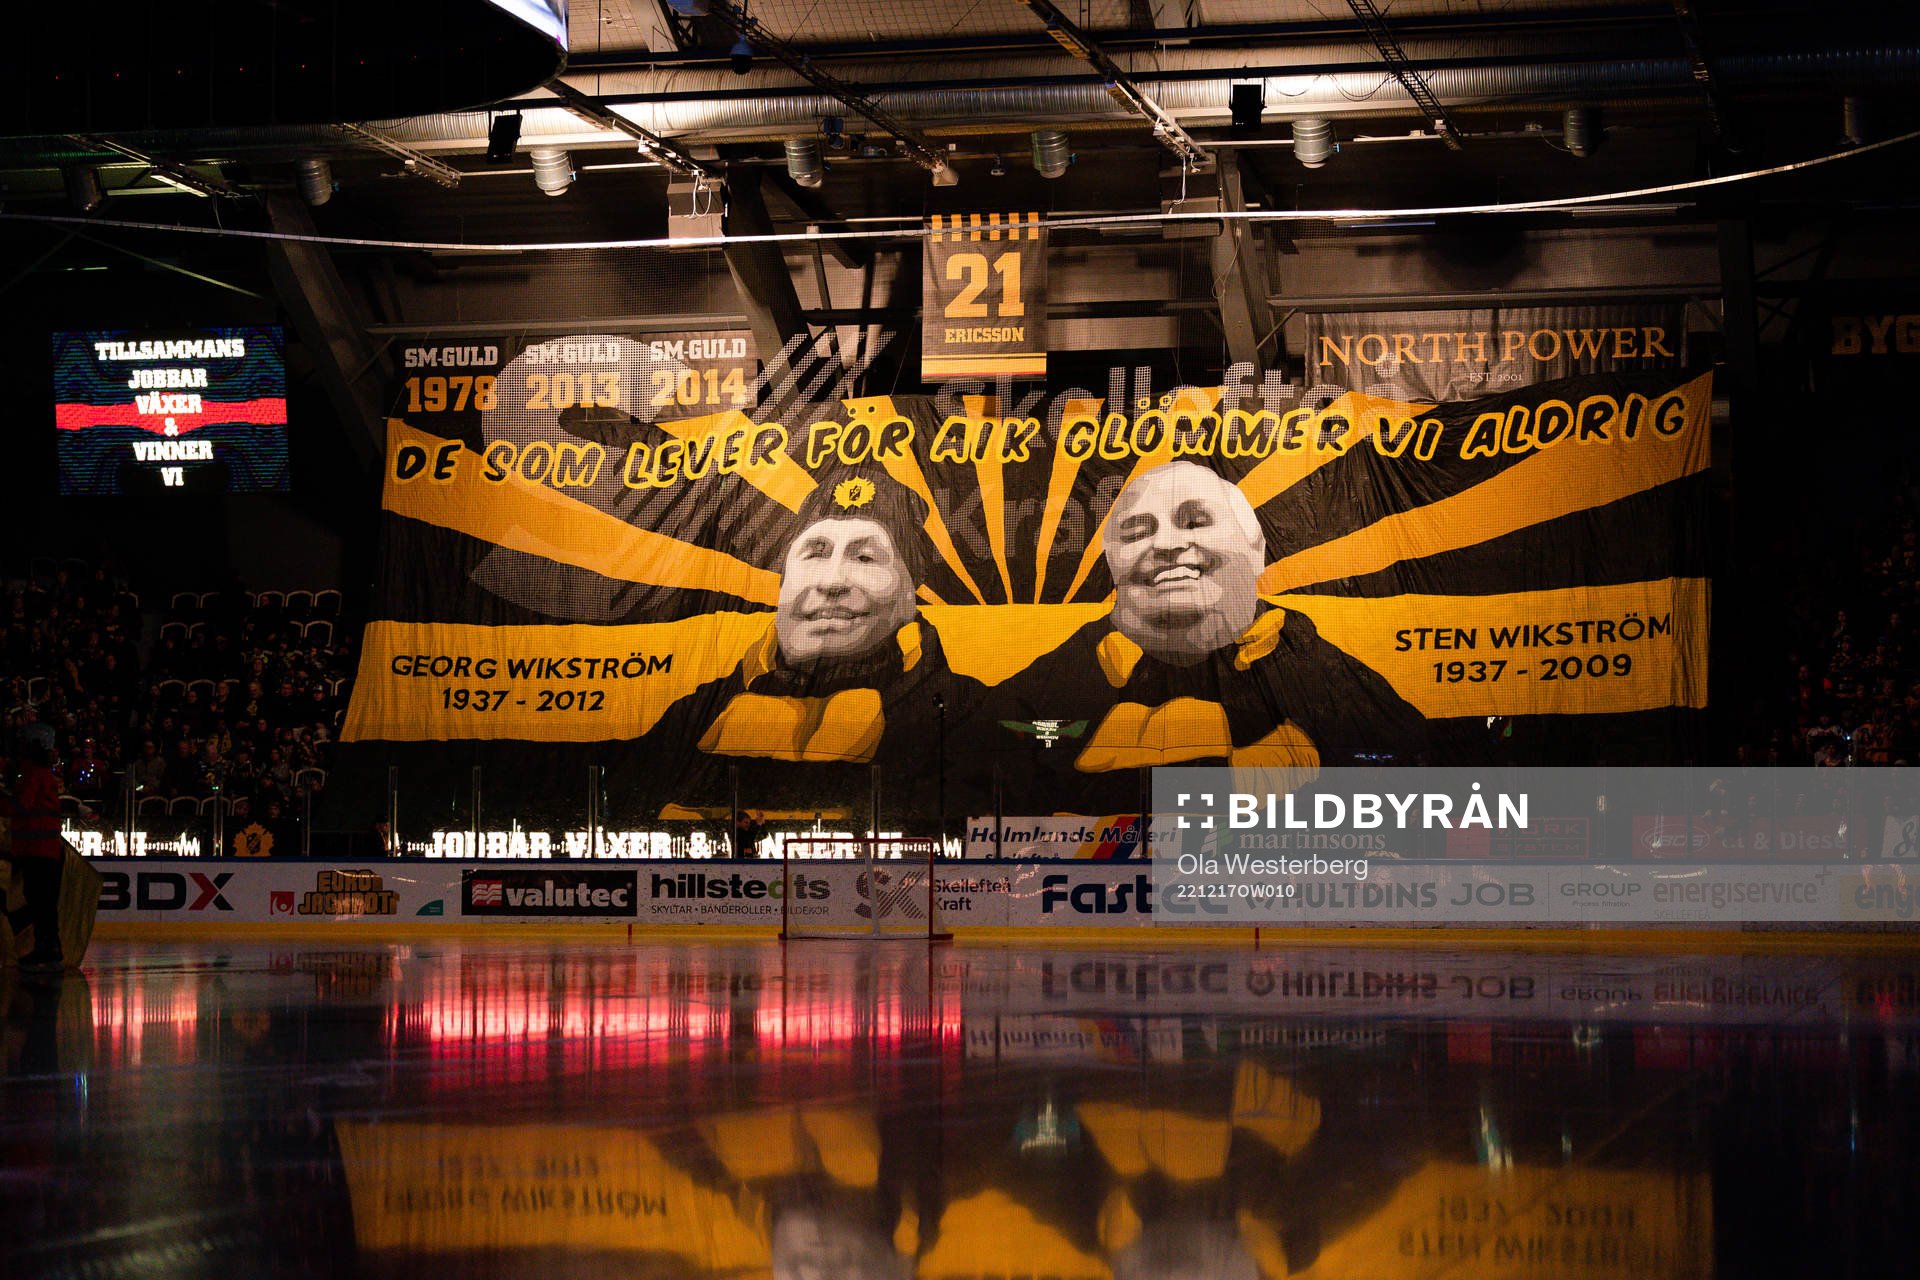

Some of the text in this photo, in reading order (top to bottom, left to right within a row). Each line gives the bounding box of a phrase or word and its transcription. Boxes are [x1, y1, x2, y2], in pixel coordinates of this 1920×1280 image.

[944, 251, 1025, 318] 21
[944, 327, 1025, 344] ERICSSON
[1318, 326, 1675, 367] NORTH POWER
[95, 339, 245, 361] TILLSAMMANS
[404, 346, 499, 369] SM-GULD
[525, 341, 622, 364] SM-GULD
[650, 337, 747, 360] SM-GULD
[128, 368, 208, 389] JOBBAR
[650, 366, 749, 407] 2014
[134, 391, 203, 415] VÄXER
[404, 375, 498, 413] 1978
[525, 371, 622, 411] 2013
[164, 417, 179, 437] &
[132, 440, 214, 461] VINNER
[390, 390, 1693, 490] DE SOM LEVER FÖR AIK GLÖMMER VI ALDRIG
[161, 467, 184, 486] VI
[1395, 612, 1672, 652] STEN WIKSTRÖM
[391, 652, 674, 680] GEORG WIKSTRÖM
[1433, 660, 1508, 683] 1937
[1539, 653, 1632, 681] 2009
[442, 687, 510, 711] 1937
[535, 690, 605, 711] 2012
[970, 826, 1095, 843] Holmlunds
[1239, 829, 1386, 850] martinsons
[504, 880, 629, 907] valutec
[1282, 882, 1438, 909] HULTDINS
[1450, 882, 1535, 907] JOB
[1560, 882, 1642, 897] GROUP
[651, 904, 693, 915] SKYLTAR
[700, 904, 772, 915] BANDEROLLER
